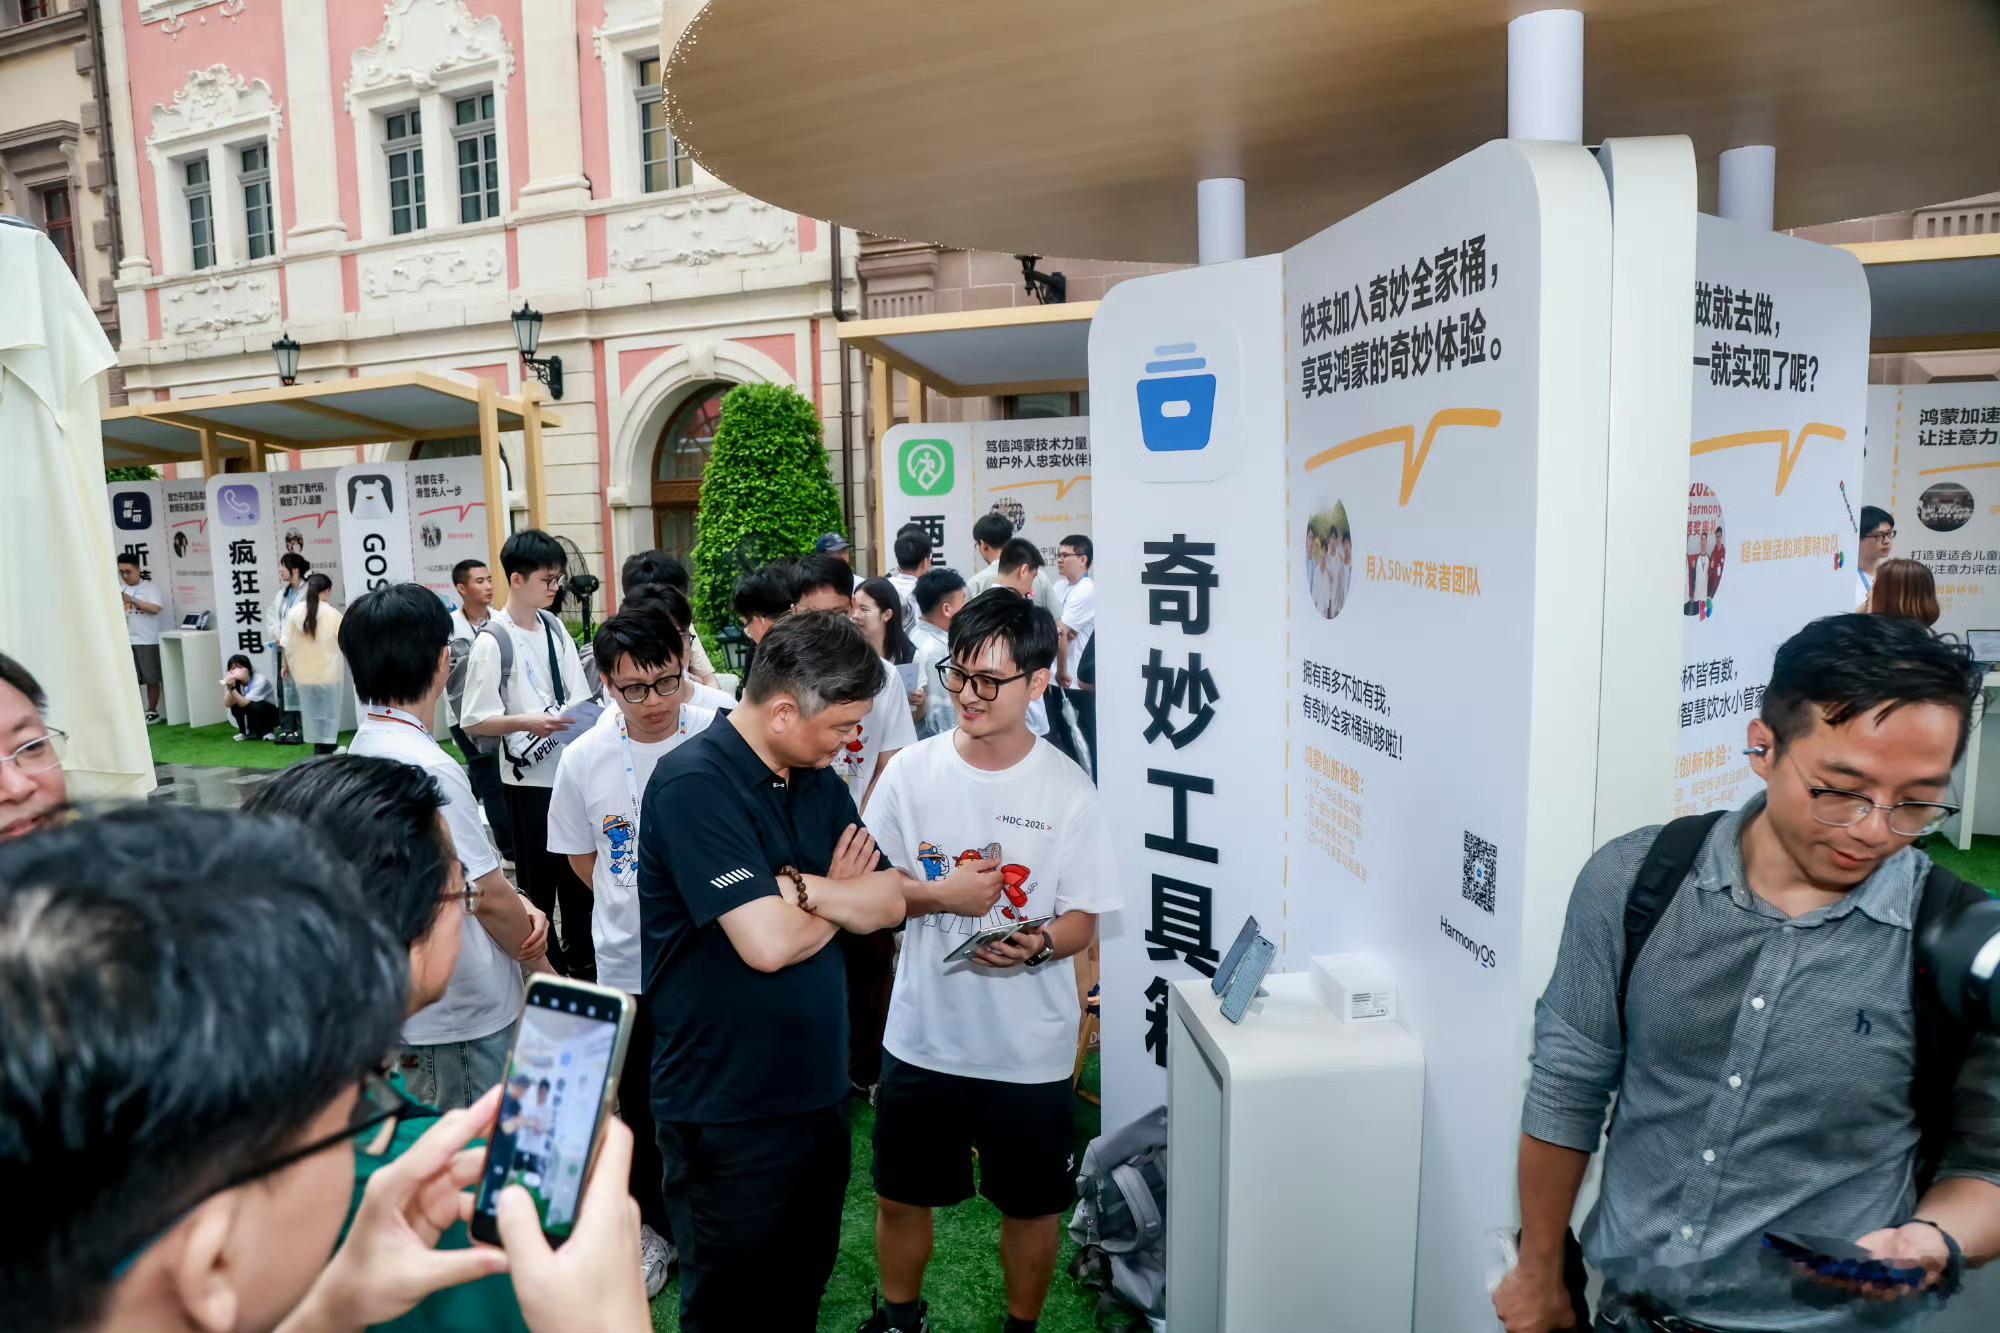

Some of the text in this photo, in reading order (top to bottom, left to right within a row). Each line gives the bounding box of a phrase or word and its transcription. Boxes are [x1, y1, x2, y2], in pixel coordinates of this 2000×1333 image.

[1301, 234, 1498, 346] 快来加入奇妙全家桶，
[1301, 308, 1502, 399] 享受鸿蒙的奇妙体验。
[986, 437, 1087, 453] 笃信鸿蒙技术力量
[1918, 428, 2000, 447] 让注意力
[910, 515, 946, 566] 两
[1911, 550, 2000, 560] 打造更适合儿童
[229, 539, 264, 654] 疯狂来电
[1303, 658, 1391, 717] 拥有再多不如有我，
[1303, 694, 1402, 761] 有奇妙全家桶就够啦！
[1440, 915, 1496, 968] HarmonyOS
